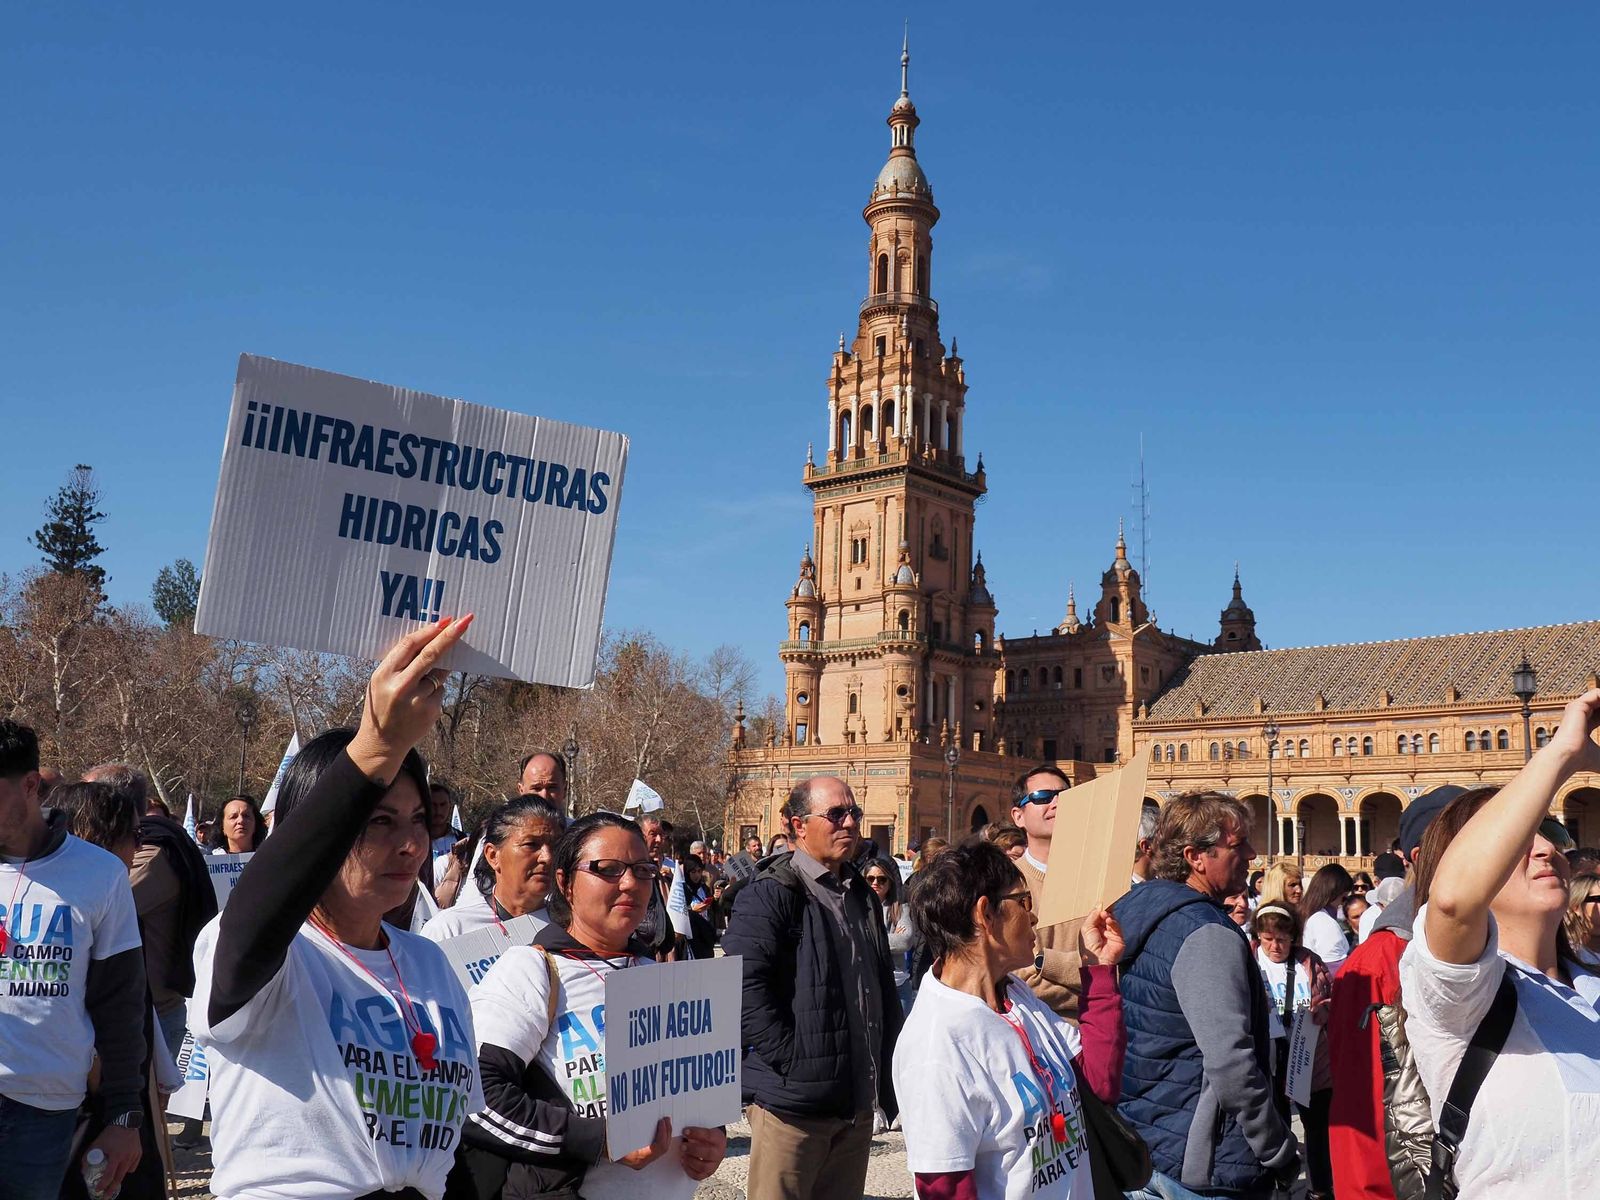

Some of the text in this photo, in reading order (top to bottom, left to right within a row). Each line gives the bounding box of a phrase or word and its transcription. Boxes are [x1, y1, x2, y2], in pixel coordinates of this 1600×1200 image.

[242, 401, 611, 515] ¡¡INFRAESTRUCTURAS
[338, 492, 504, 564] HIDRICAS
[380, 570, 446, 623] YA!!
[13, 945, 73, 961] CAMPO
[9, 982, 69, 997] MUNDO
[629, 998, 712, 1048] ¡¡SIN AGUA
[337, 1043, 388, 1076] ARA
[421, 1059, 474, 1093] AMPO
[611, 1048, 736, 1115] NO HAY FUTURO!!
[1031, 1159, 1066, 1193] PARA
